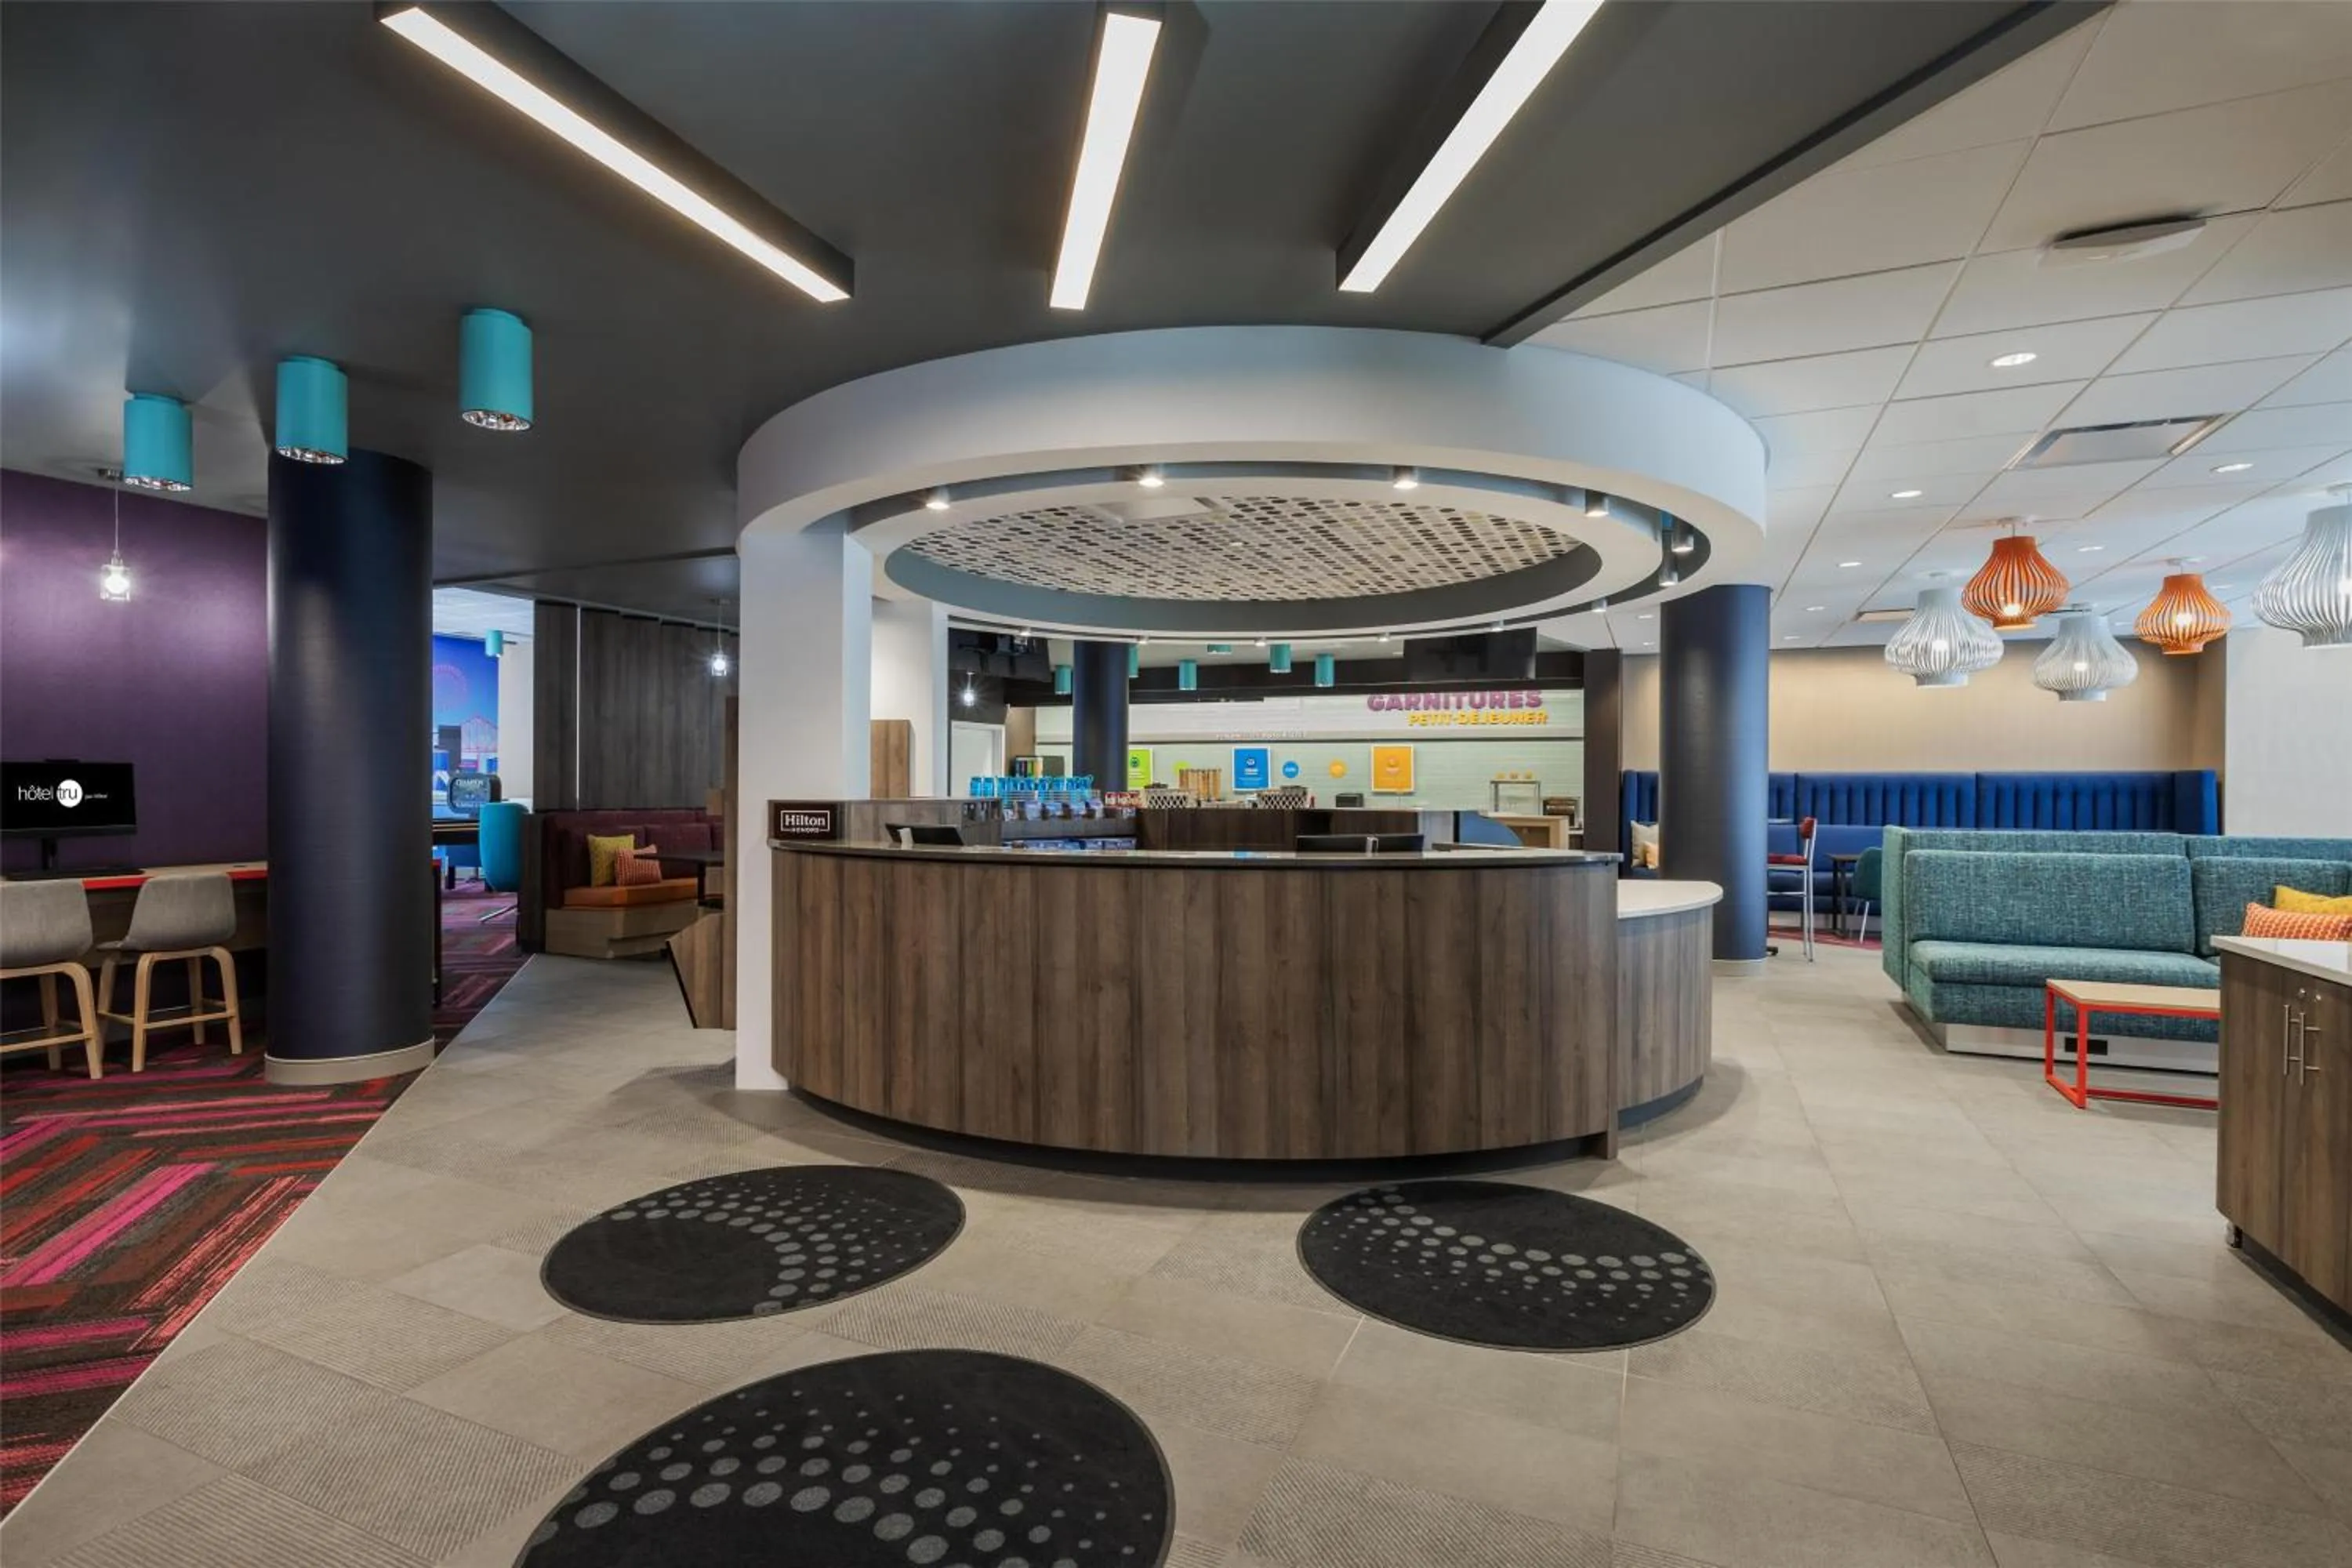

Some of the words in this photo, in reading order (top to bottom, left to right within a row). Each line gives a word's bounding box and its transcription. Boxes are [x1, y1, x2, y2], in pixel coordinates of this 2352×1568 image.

[1367, 691, 1543, 711] GARNITURES
[18, 785, 54, 800] hôtel
[57, 786, 78, 800] tru
[785, 815, 826, 826] Hilton
